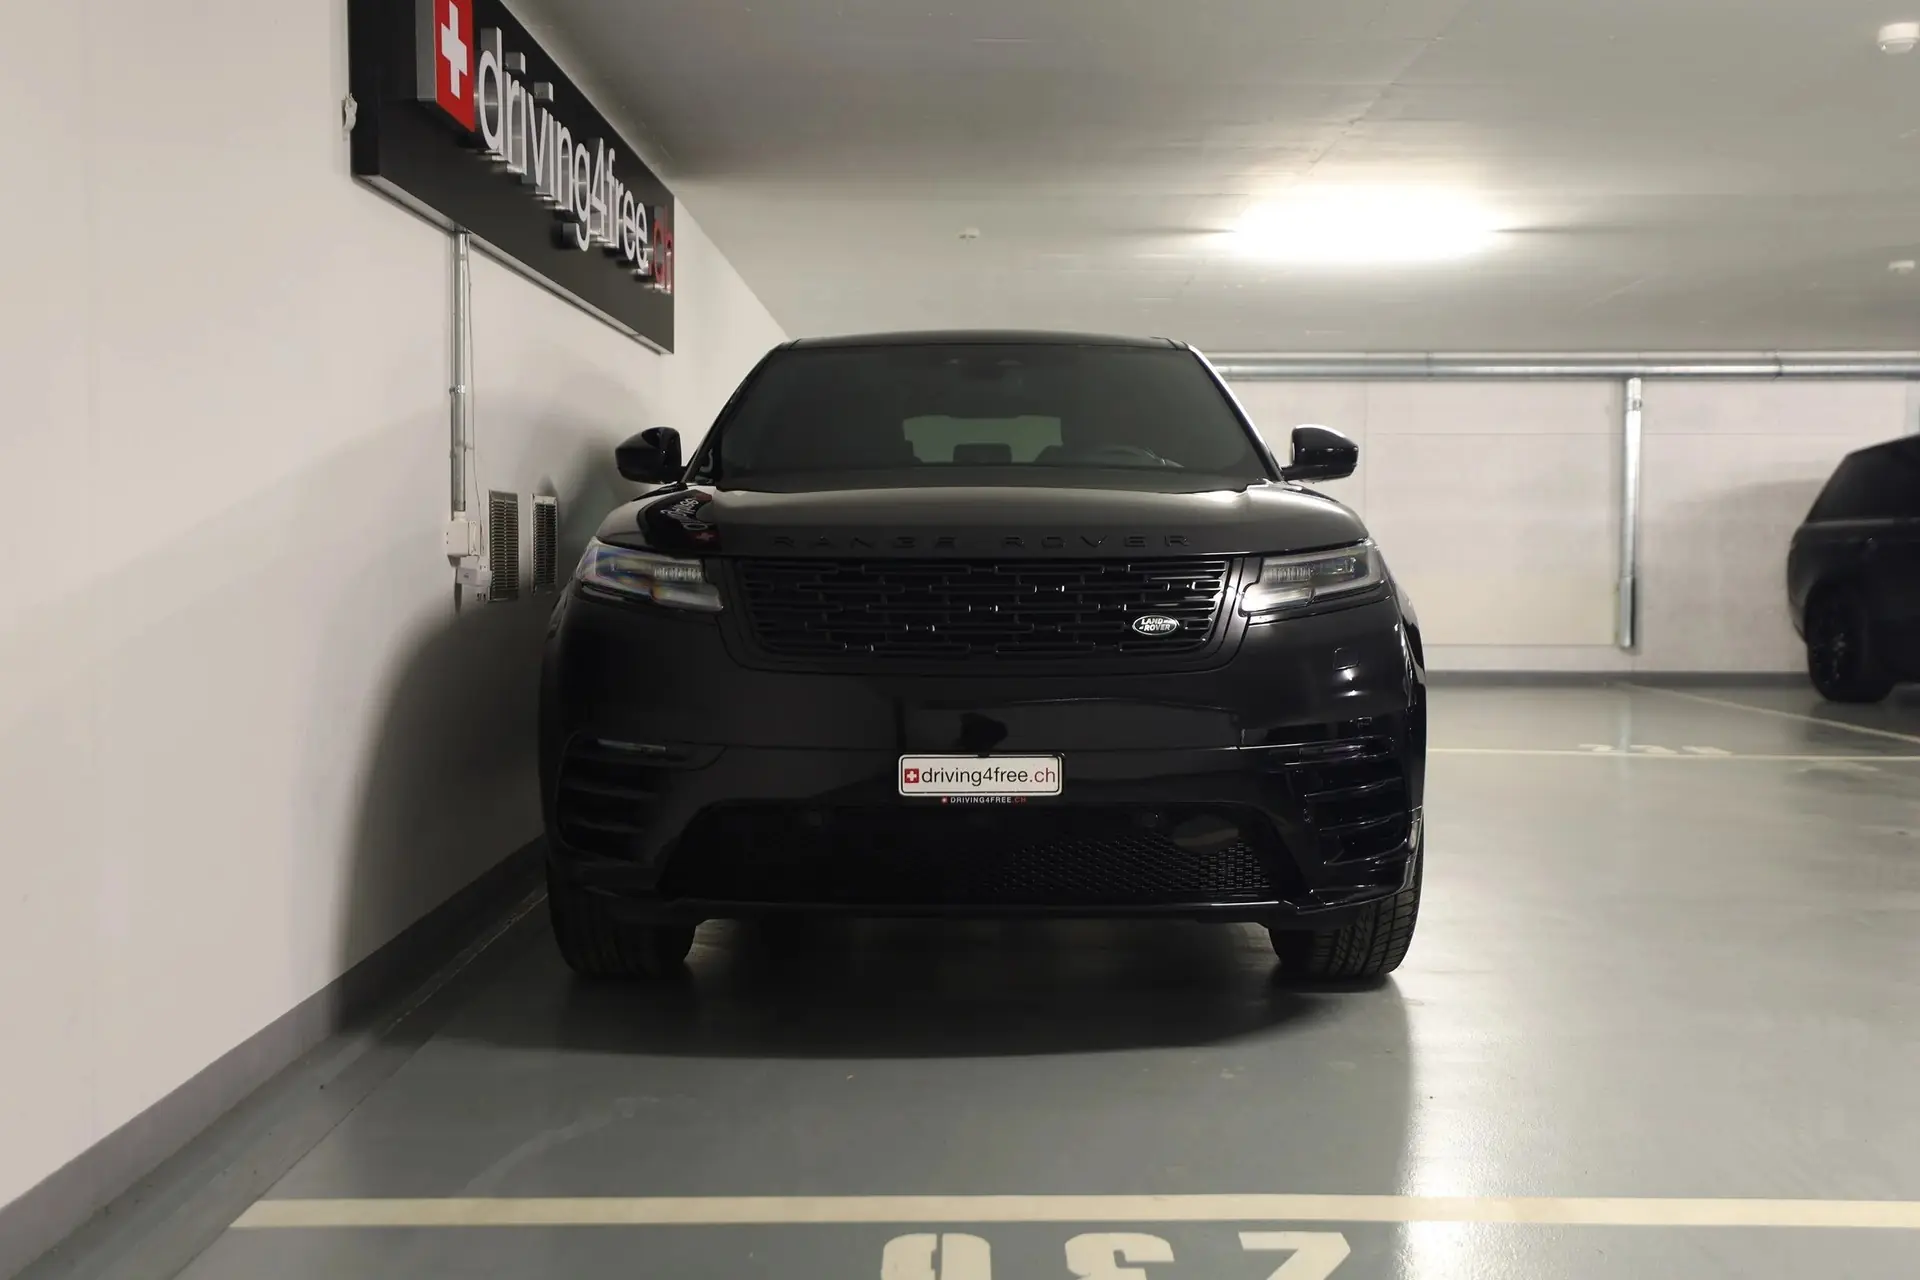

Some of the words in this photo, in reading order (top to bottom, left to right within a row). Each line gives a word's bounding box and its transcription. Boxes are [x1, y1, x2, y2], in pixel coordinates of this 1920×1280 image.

[772, 535, 959, 549] RANGE
[1001, 535, 1191, 549] ROVER
[921, 767, 1056, 787] driving4free.ch
[950, 796, 1027, 804] DRIVING4FREE.CH
